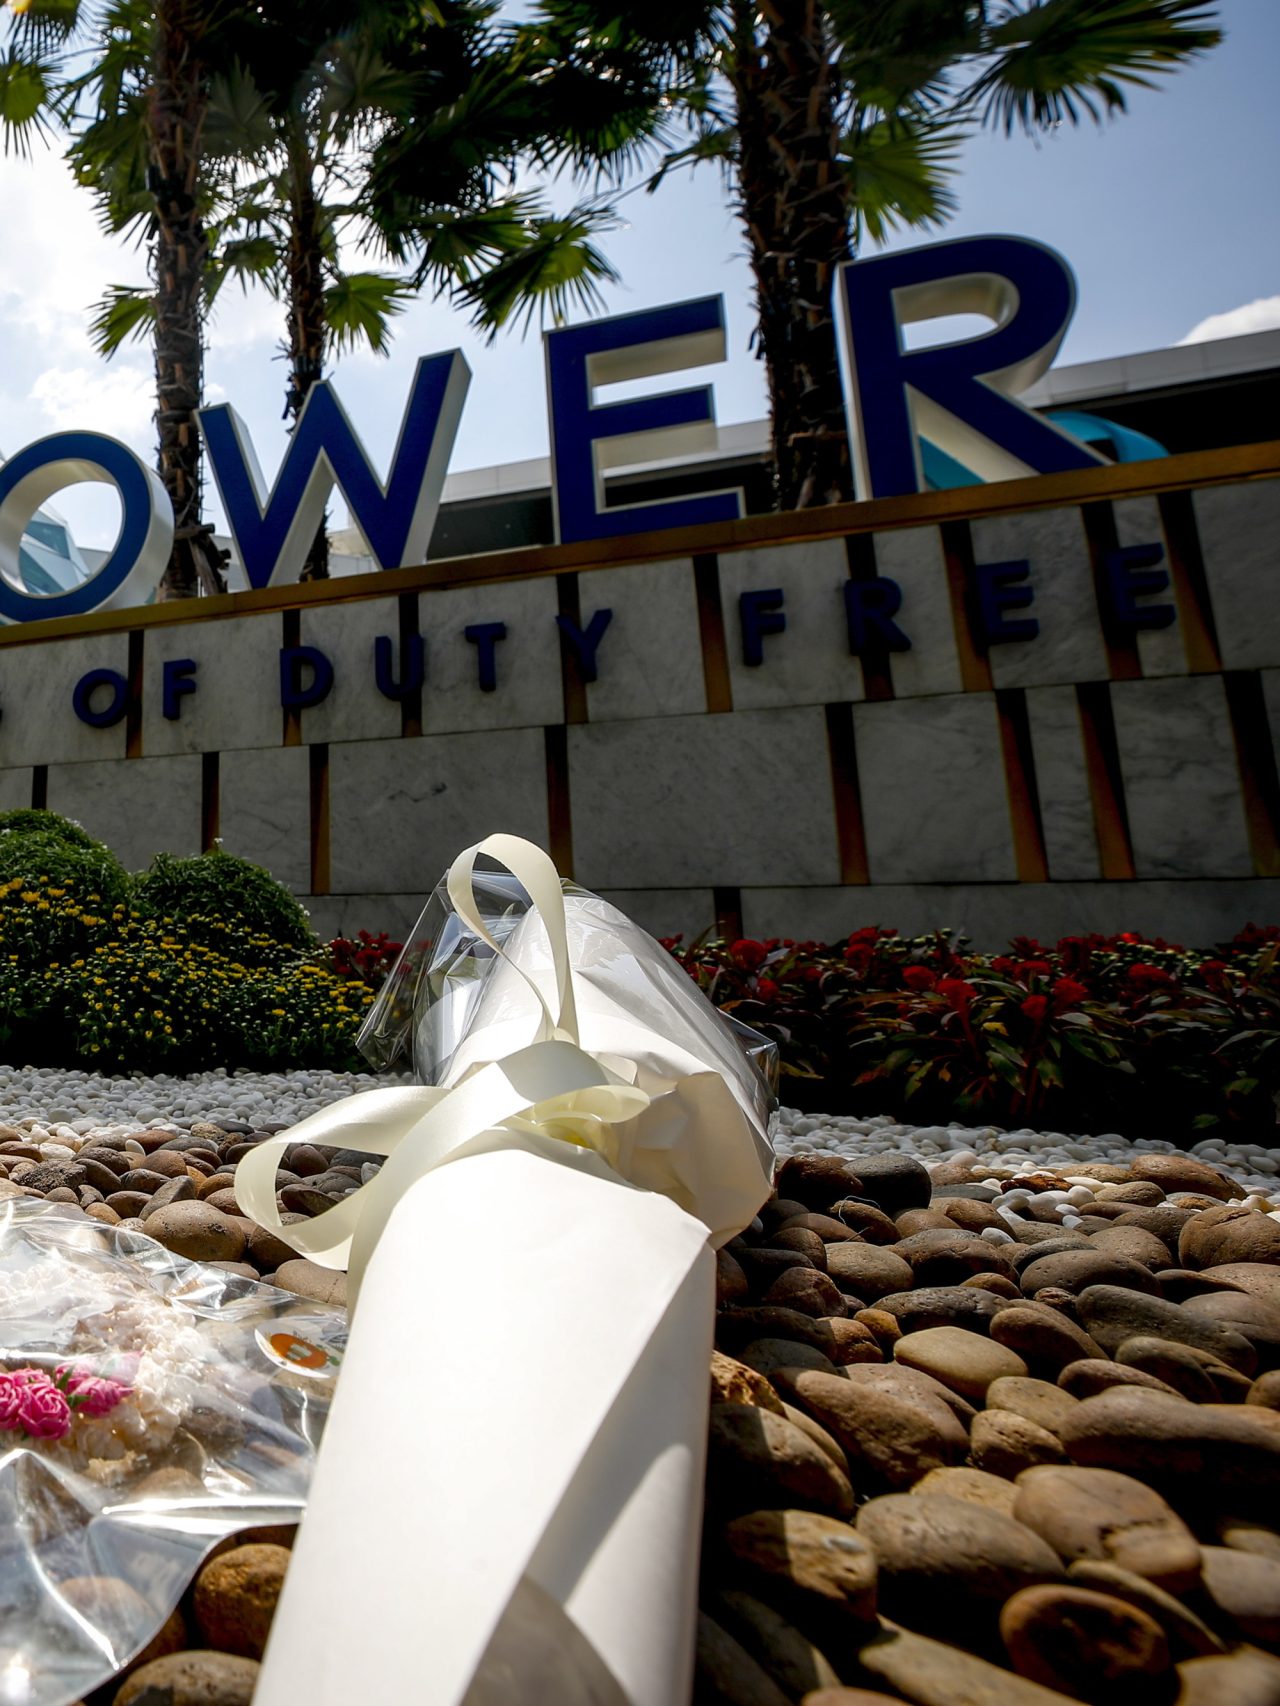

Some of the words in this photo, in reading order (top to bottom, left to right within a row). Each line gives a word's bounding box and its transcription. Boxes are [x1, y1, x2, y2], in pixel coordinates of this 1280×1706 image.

[72, 658, 198, 729] OF
[280, 608, 613, 710] DUTY
[740, 542, 1177, 667] FREE
